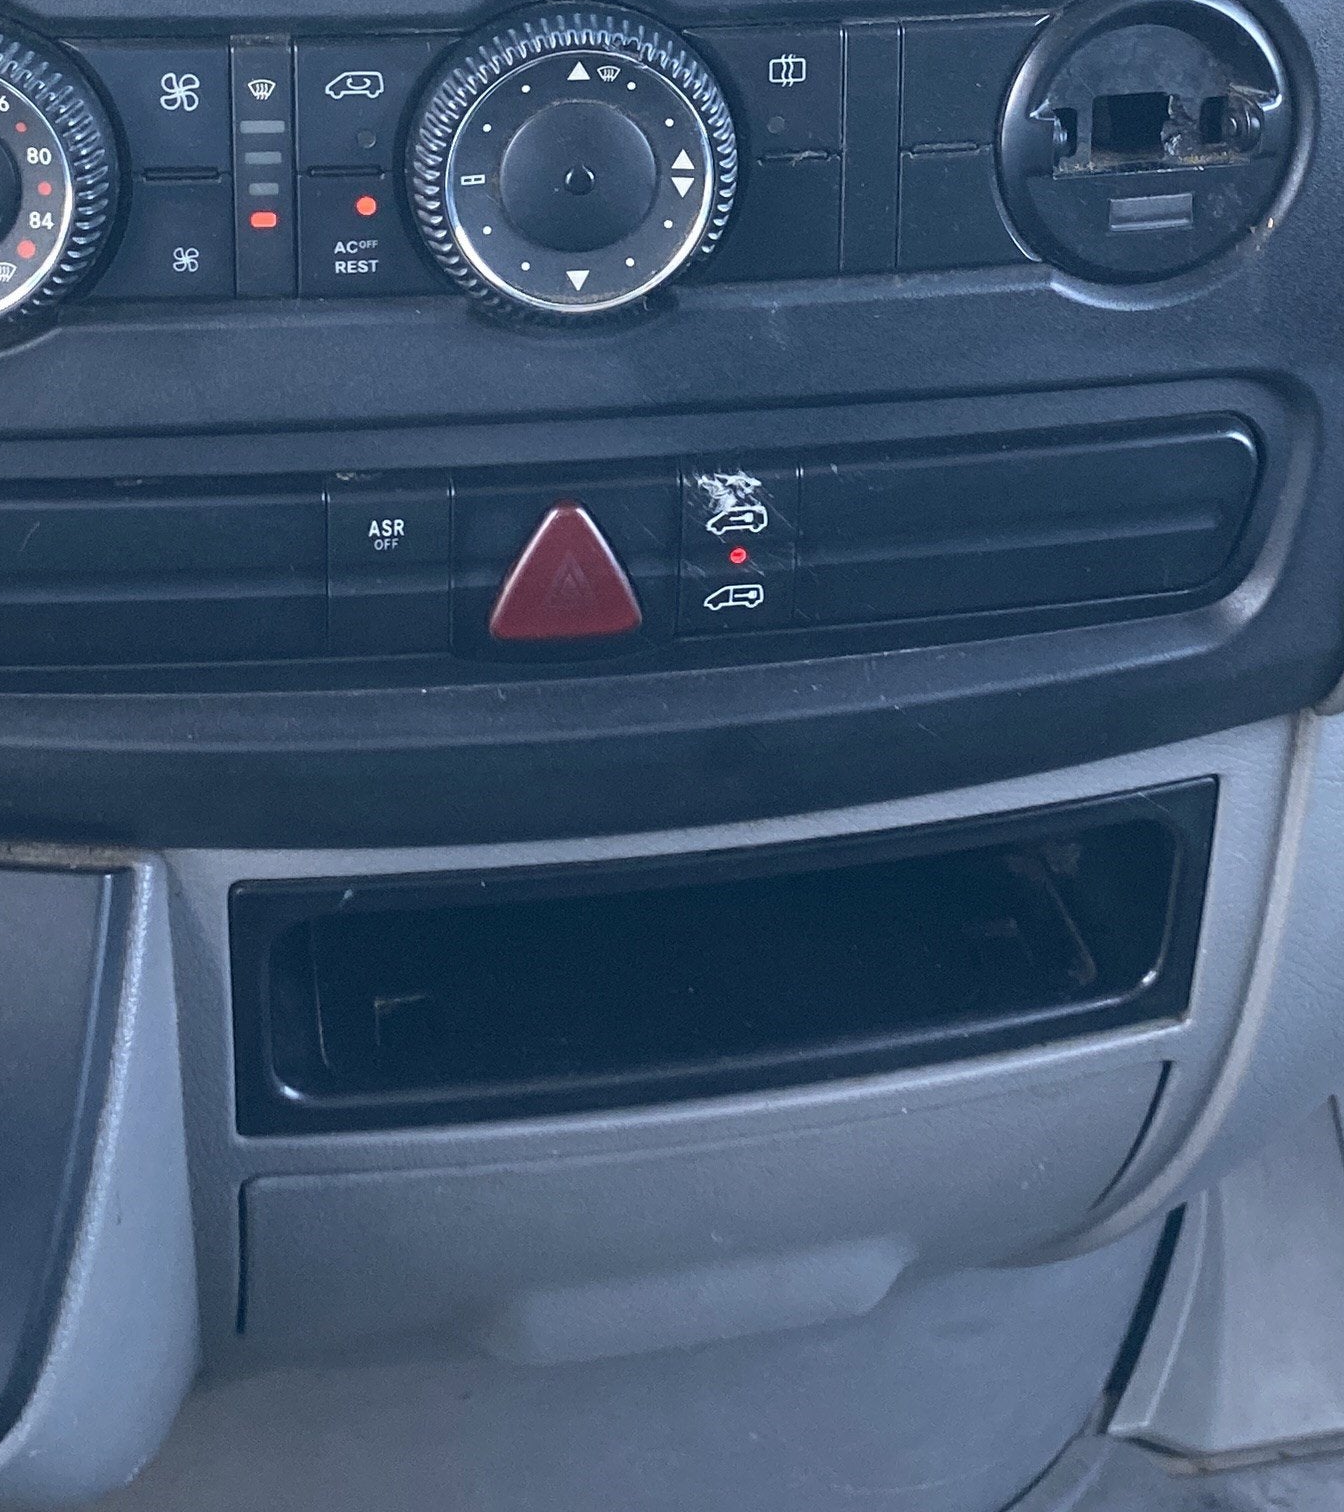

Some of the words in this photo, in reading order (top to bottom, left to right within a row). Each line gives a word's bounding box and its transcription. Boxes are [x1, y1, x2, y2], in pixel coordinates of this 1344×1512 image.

[25, 146, 53, 166] 80
[28, 210, 55, 230] 84
[334, 259, 379, 275] REST
[368, 519, 406, 538] ASR
[373, 537, 400, 552] OFF
